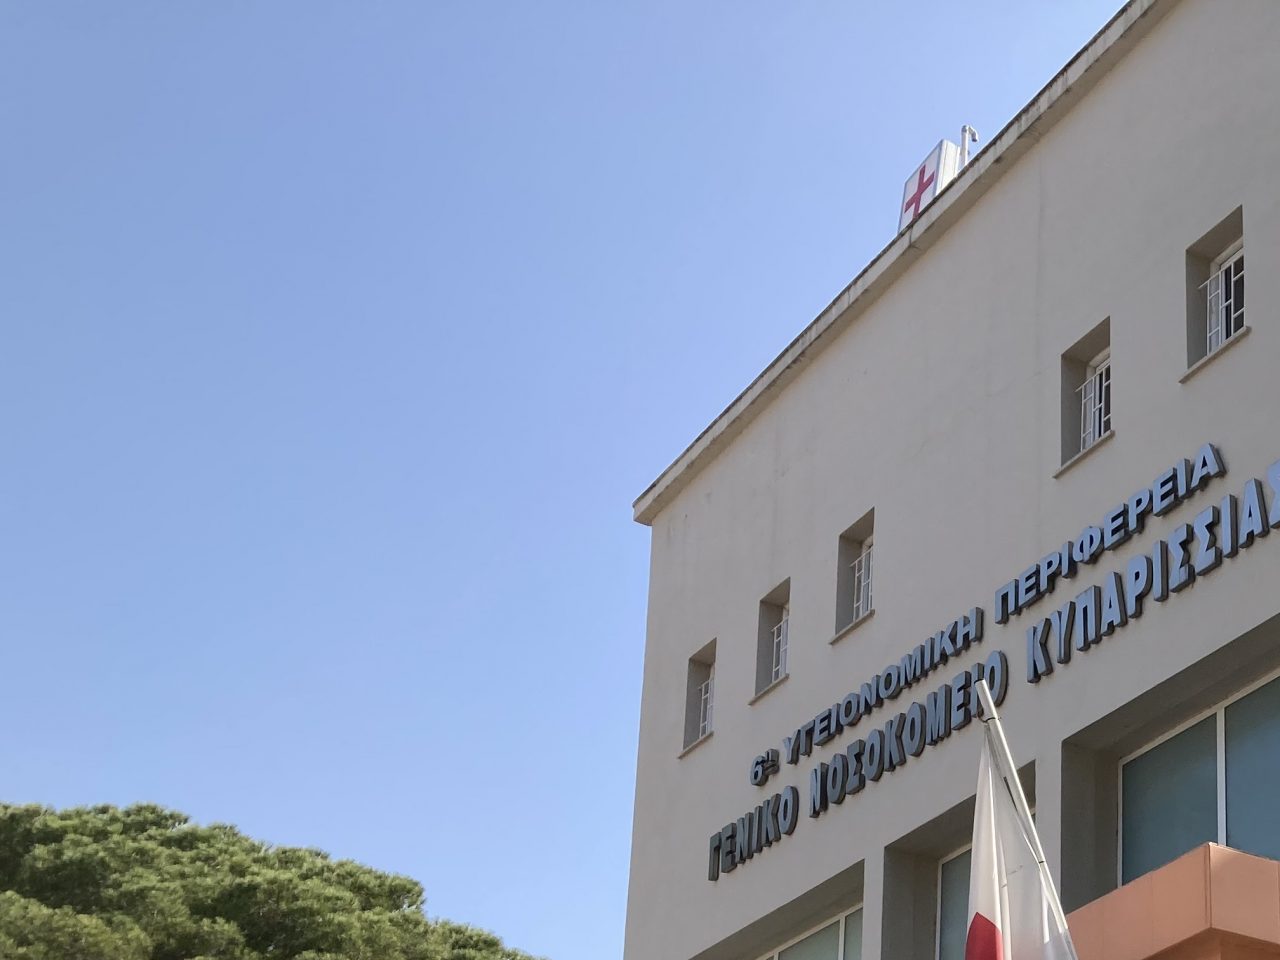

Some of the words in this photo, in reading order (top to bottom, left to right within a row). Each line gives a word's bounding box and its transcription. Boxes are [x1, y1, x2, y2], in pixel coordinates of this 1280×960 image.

[783, 607, 984, 765] ΥΓΕΙΟΝΟΜΙΚΗ
[995, 443, 1227, 624] ΠΕΡΙΦΕΡΕΙΑ
[708, 785, 798, 882] ΓΕΝΙΚΟ
